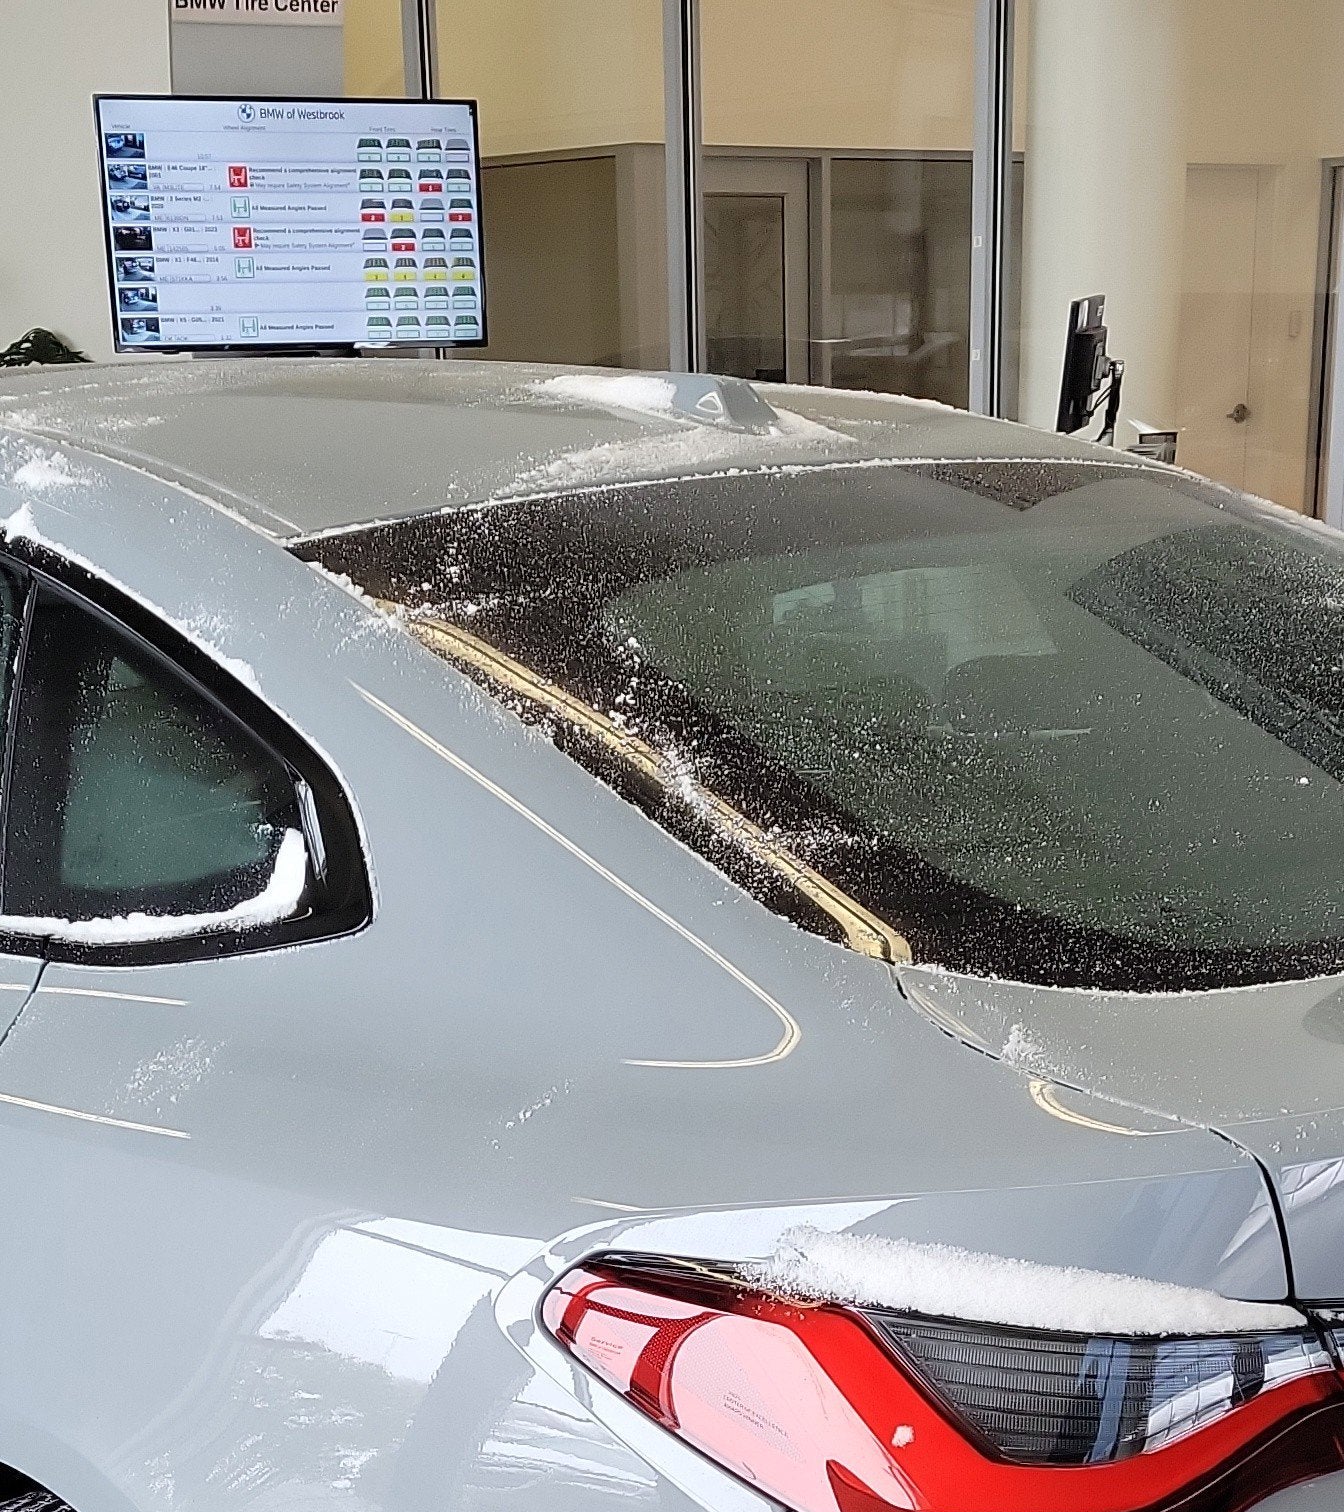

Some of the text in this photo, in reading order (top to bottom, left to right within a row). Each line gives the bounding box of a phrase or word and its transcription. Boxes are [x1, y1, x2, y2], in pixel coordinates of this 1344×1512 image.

[174, 0, 339, 13] BMW Tire Center
[259, 108, 345, 120] BMW of Westbrook
